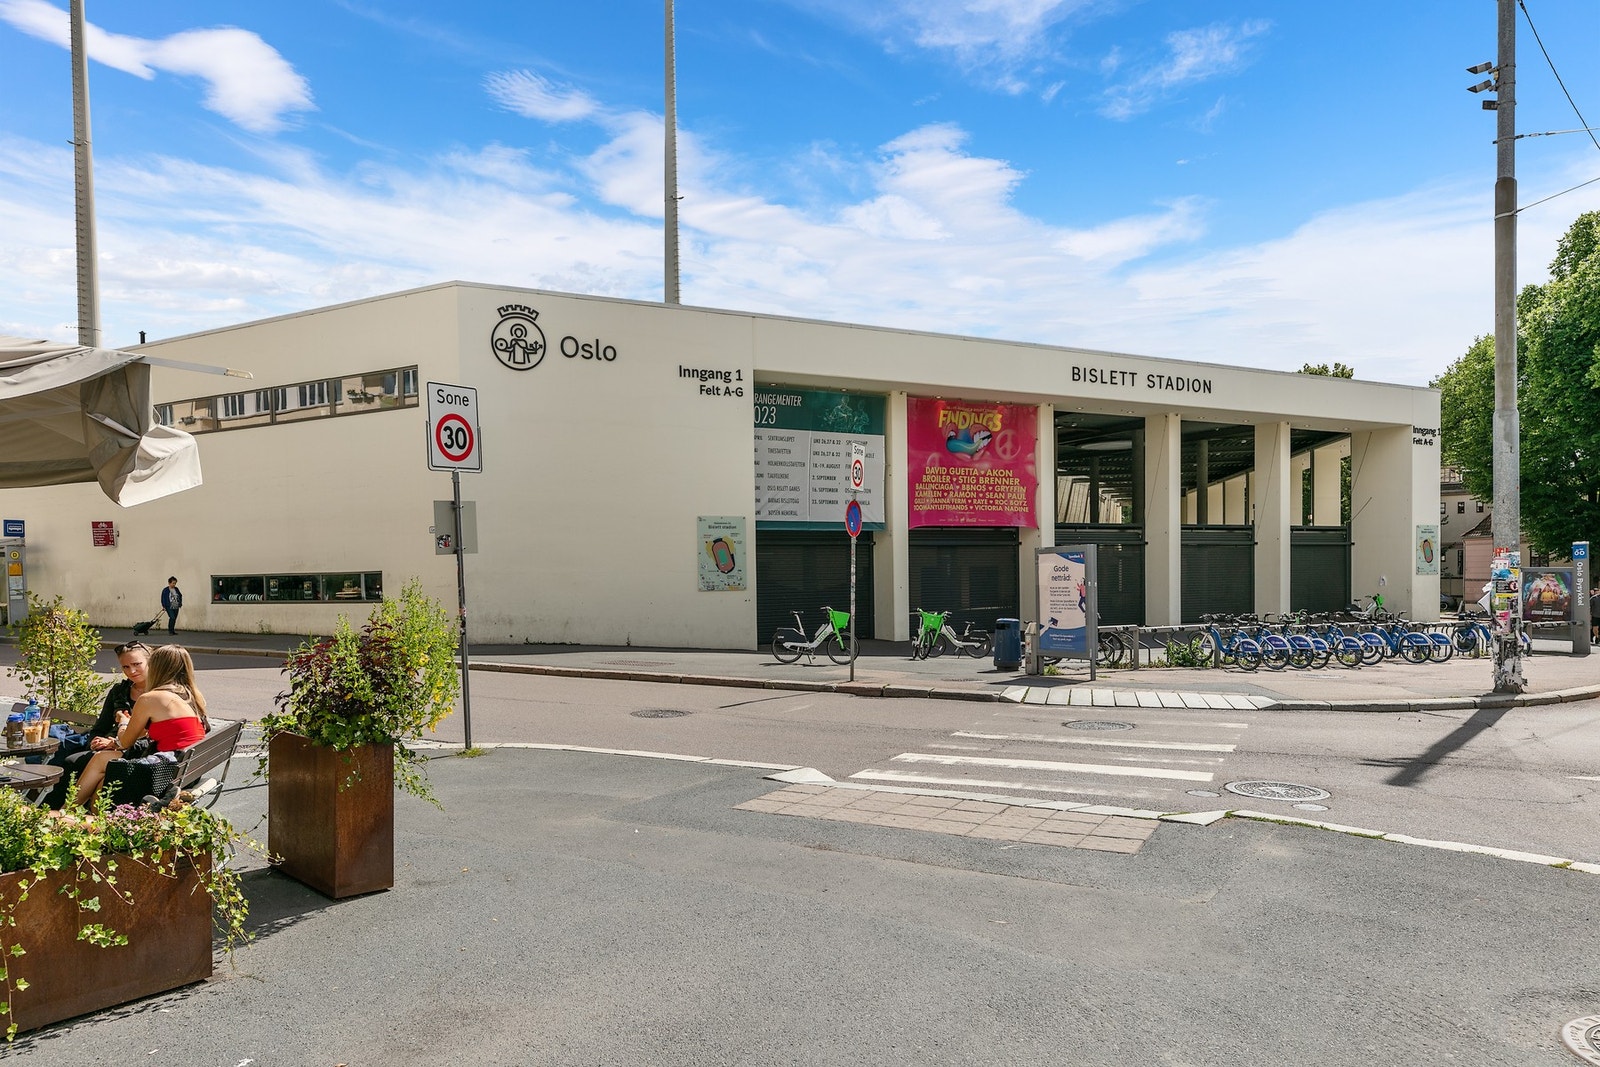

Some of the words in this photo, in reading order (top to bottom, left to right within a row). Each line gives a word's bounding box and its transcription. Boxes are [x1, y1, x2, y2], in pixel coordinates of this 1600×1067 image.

[560, 336, 617, 361] Oslo
[679, 365, 732, 383] Inngang
[735, 369, 743, 382] 1
[1072, 366, 1138, 387] BISLETT
[1147, 374, 1211, 394] STADION
[437, 389, 469, 407] Sone
[699, 385, 720, 397] Felt
[722, 386, 743, 398] A-G
[443, 426, 468, 450] 30
[1413, 425, 1437, 438] Inngang
[1413, 437, 1423, 446] Felt
[854, 445, 864, 456] Sone
[925, 466, 948, 475] DAVID
[949, 467, 979, 476] GUETTA
[986, 469, 1013, 477] AKON
[922, 474, 951, 483] BROILER
[958, 476, 977, 484] STIG
[979, 477, 1020, 486] BRENNER
[915, 483, 954, 491] BALLINCIAGA
[994, 485, 1027, 494] GRYFFIN
[1575, 577, 1584, 606] Bysykkel
